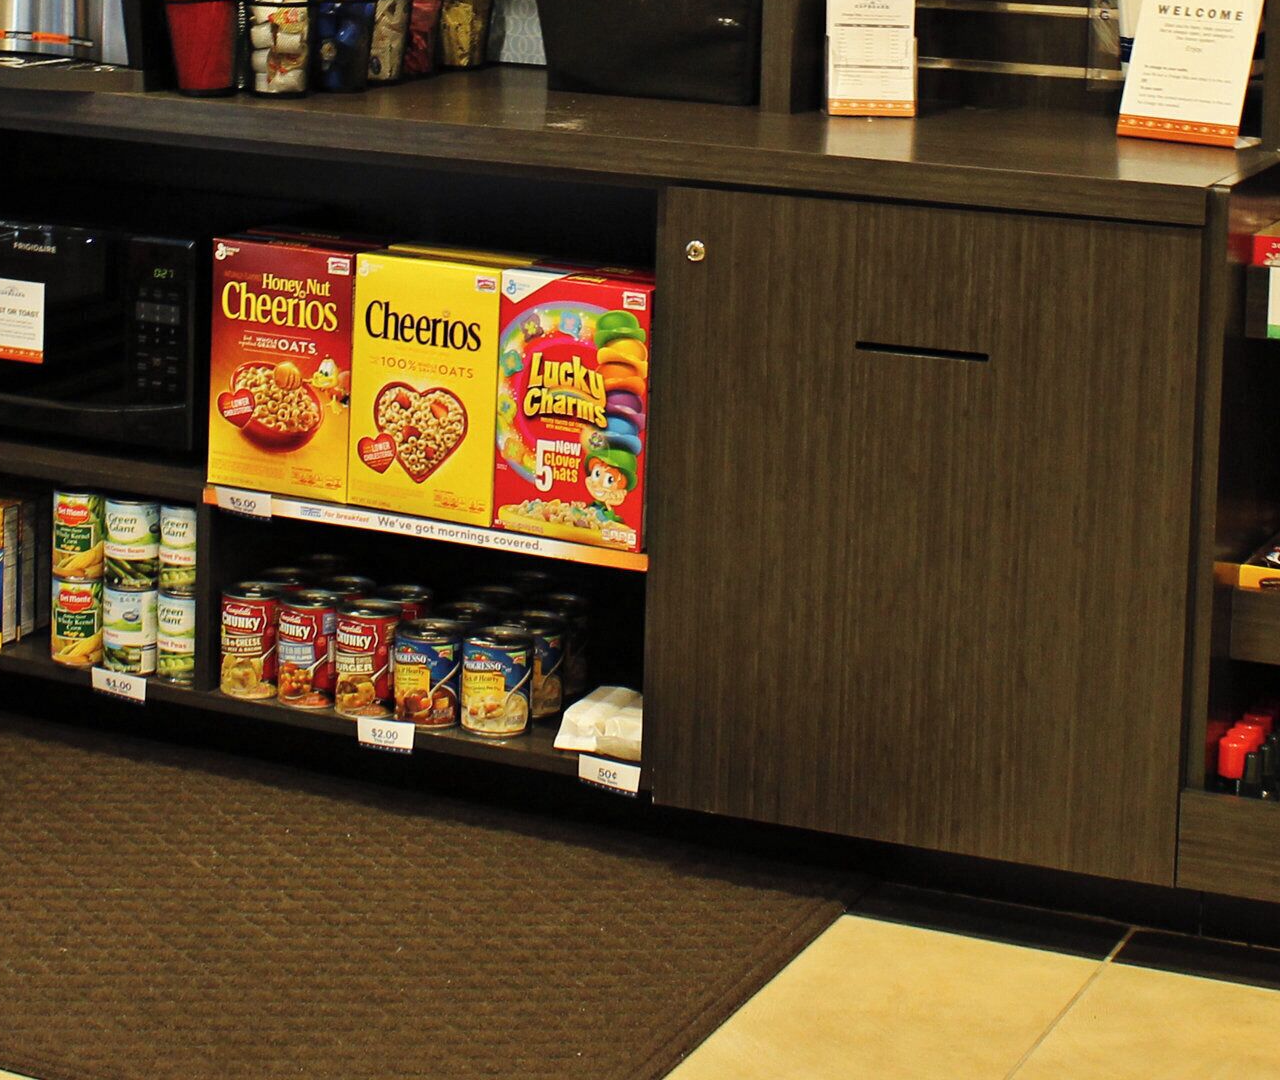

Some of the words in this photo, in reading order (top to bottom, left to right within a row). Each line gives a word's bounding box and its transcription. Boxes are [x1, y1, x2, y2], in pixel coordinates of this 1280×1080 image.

[1157, 4, 1245, 22] WELCOME
[262, 272, 301, 297] Honey
[306, 277, 331, 297] Nut
[7, 307, 19, 317] OR
[19, 308, 41, 319] TOAST
[221, 280, 339, 333] Cheerios
[365, 300, 482, 352] Cheerios
[528, 351, 607, 404] Lucky
[523, 386, 608, 429] Charms
[555, 439, 582, 457] New
[534, 439, 556, 493] 5
[552, 467, 579, 483] hats
[107, 512, 137, 525] Green
[377, 516, 410, 530] We've
[411, 520, 435, 536] got
[437, 523, 491, 546] mornings
[494, 531, 544, 552] covered.
[370, 728, 399, 741] $2.00
[597, 767, 618, 780] 50¢
